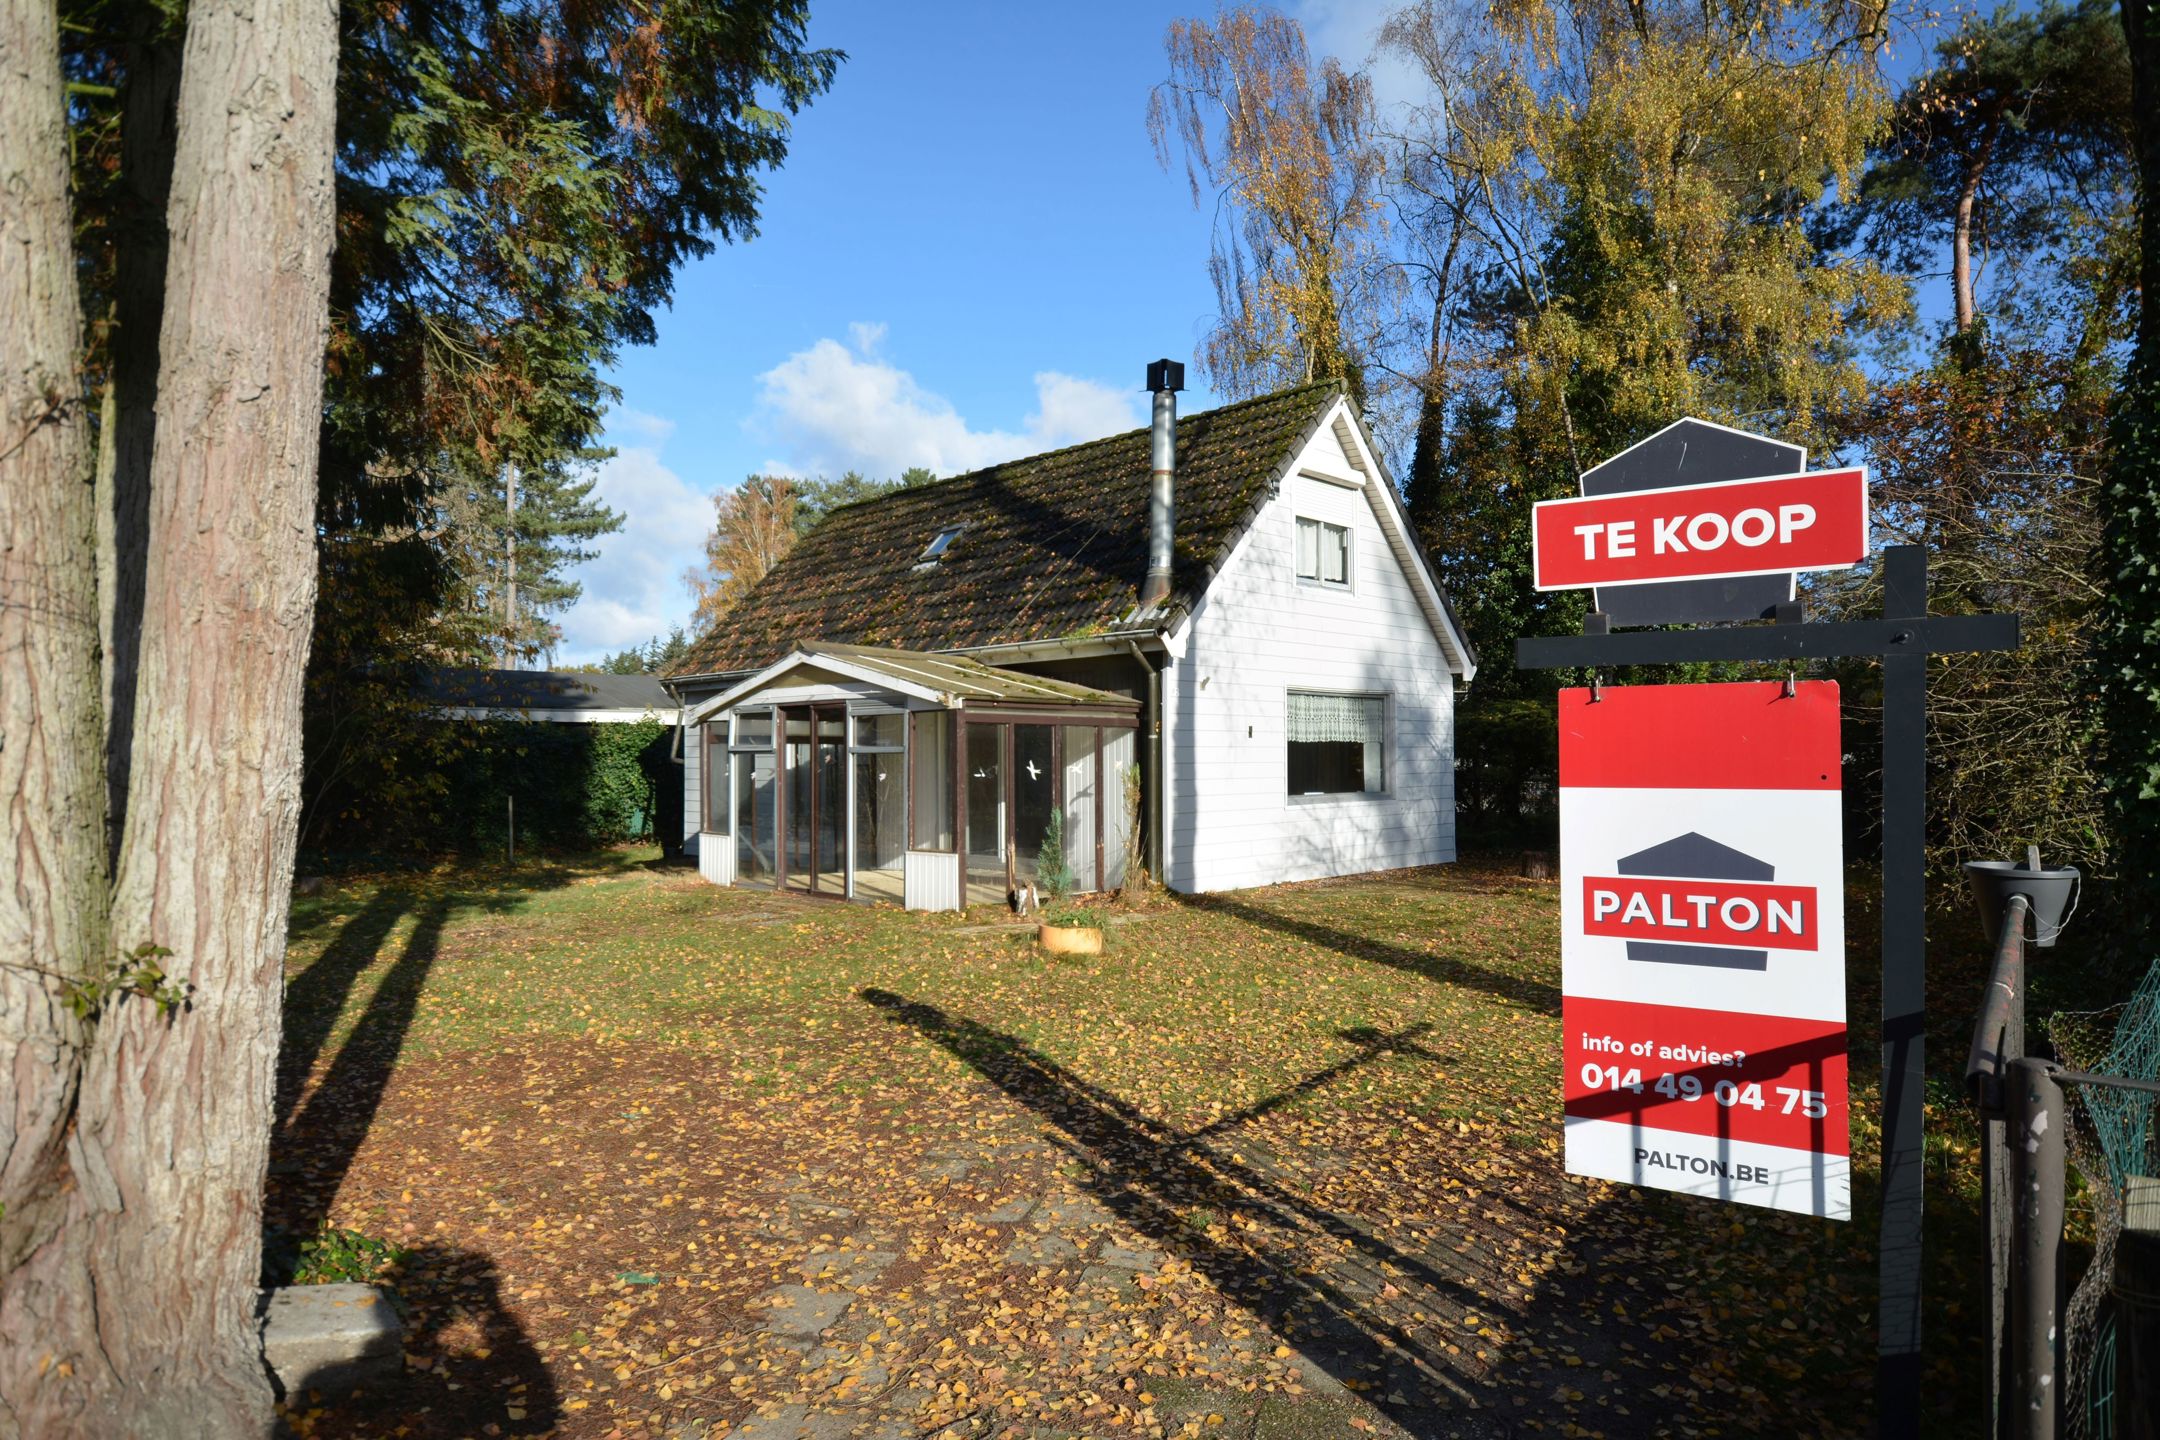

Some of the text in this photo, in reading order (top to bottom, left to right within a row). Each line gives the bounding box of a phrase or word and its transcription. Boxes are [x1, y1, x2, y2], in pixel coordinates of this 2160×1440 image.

[1574, 503, 1817, 560] TE KOOP
[1593, 890, 1804, 935] PALTON
[1582, 1032, 1746, 1068] info of advies?
[1581, 1063, 1828, 1119] 014 49 04 75
[1634, 1147, 1769, 1185] PALTON.BE
